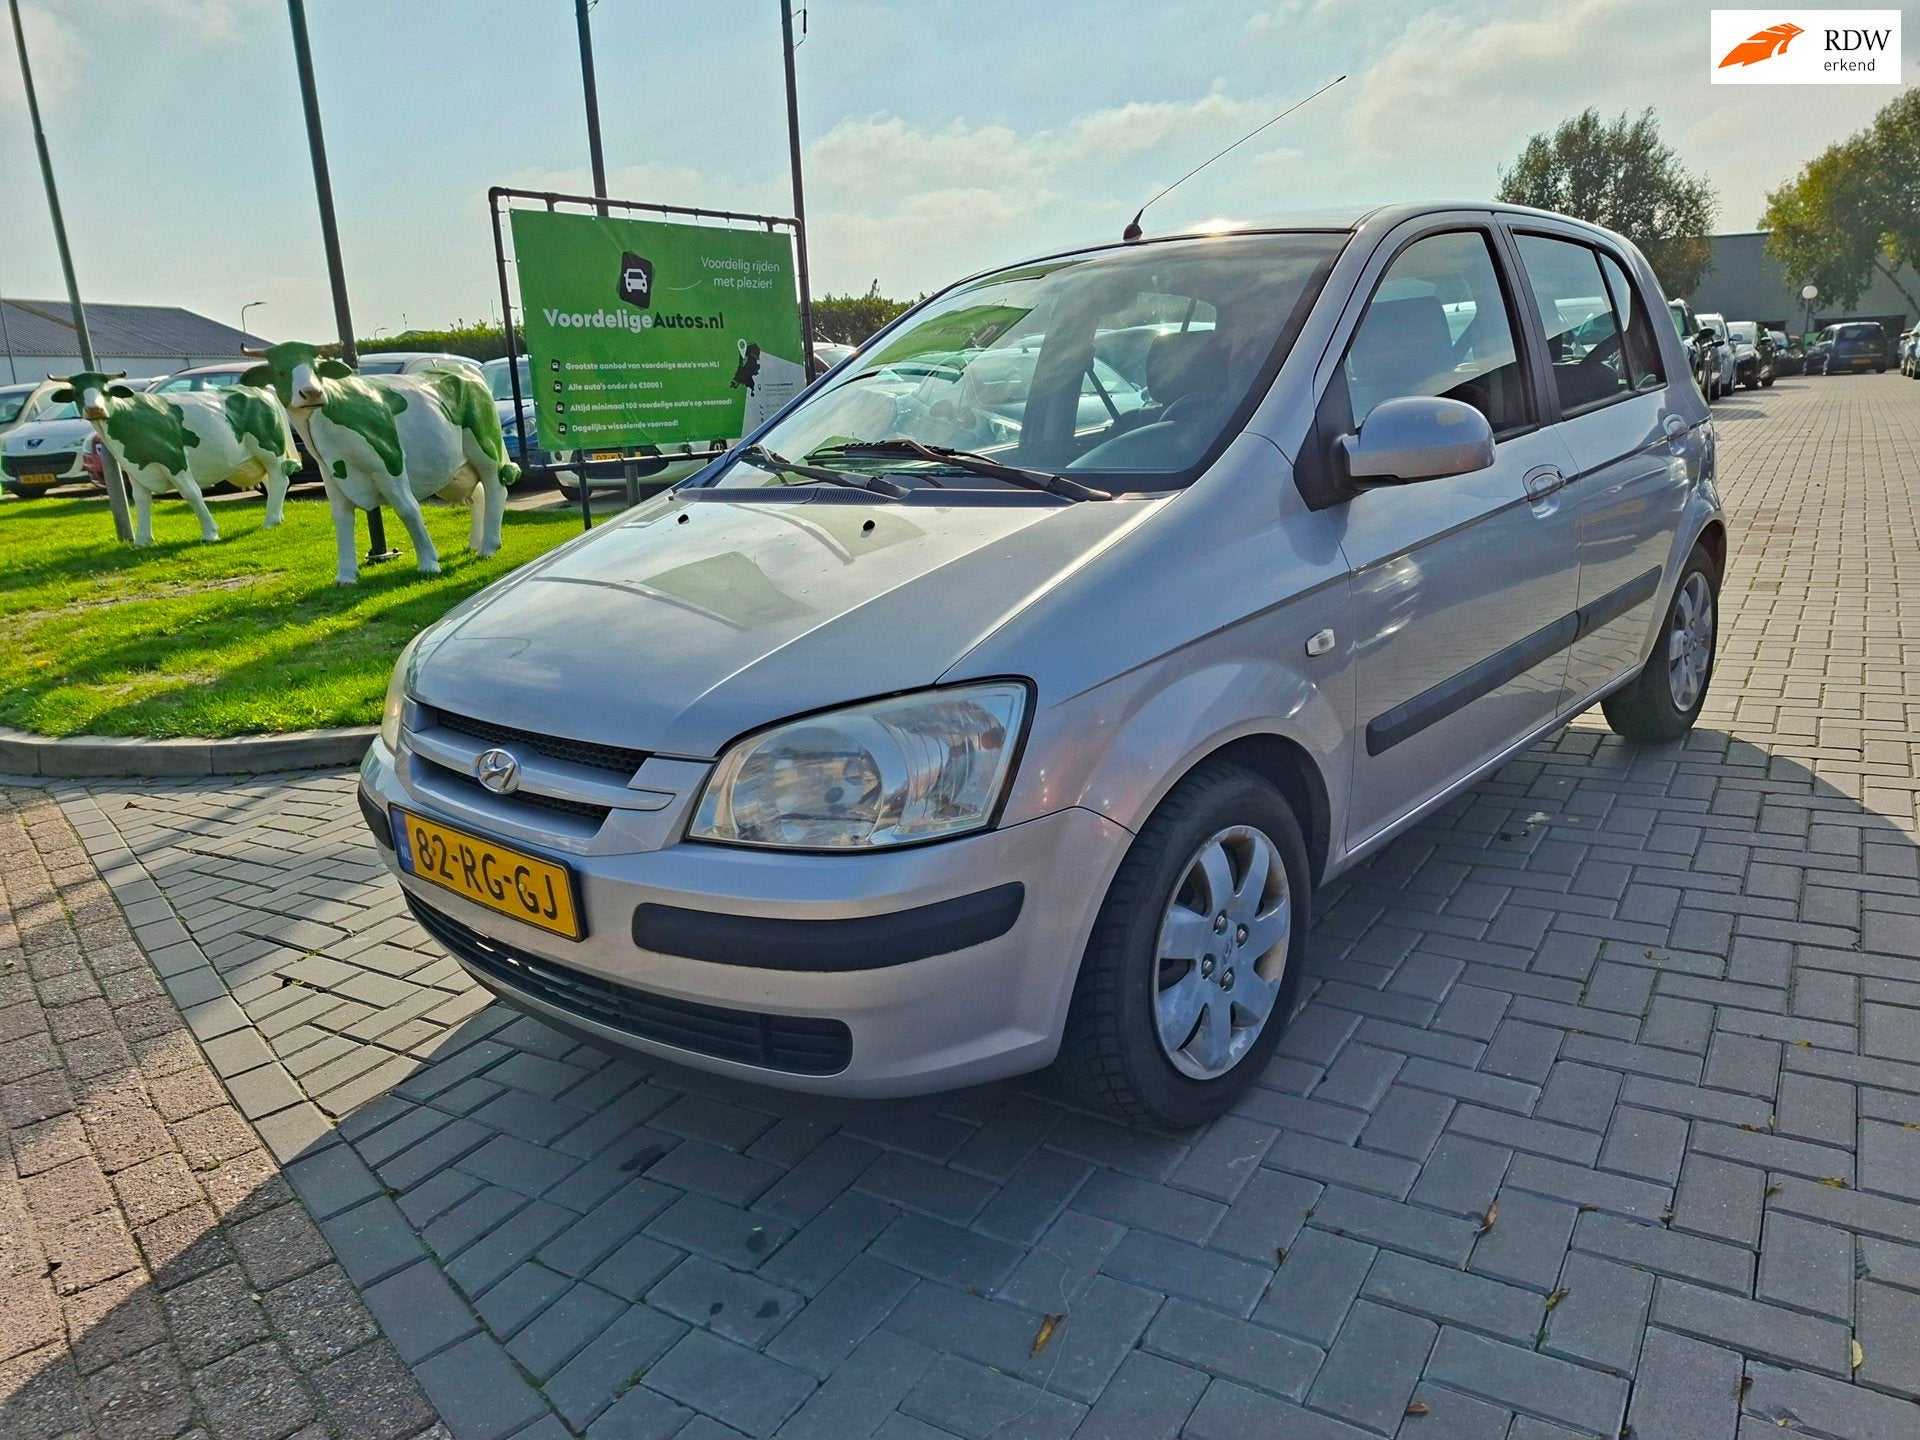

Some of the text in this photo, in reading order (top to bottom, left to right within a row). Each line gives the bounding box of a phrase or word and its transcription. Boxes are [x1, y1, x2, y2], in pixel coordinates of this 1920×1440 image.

[701, 256, 780, 275] Voordelig rijden
[713, 276, 773, 291] met plezier!
[542, 308, 725, 334] VoordeligeAutos.nl
[565, 362, 599, 371] Grootste
[599, 361, 627, 371] aanbod
[627, 362, 641, 370] van
[641, 360, 677, 371] voordelige
[676, 360, 697, 370] auto's
[697, 361, 709, 369] van
[567, 383, 583, 391] Alle
[583, 382, 607, 391] auto's
[607, 382, 629, 390] onder
[628, 382, 638, 390] de
[570, 403, 591, 413] Altijd
[591, 402, 625, 411] minimaal
[625, 401, 638, 410] 100
[637, 400, 674, 410] voordelige
[693, 400, 703, 408] op
[571, 423, 607, 433] Dagelijks
[607, 421, 647, 431] wisselende
[400, 844, 413, 862] NL
[415, 827, 559, 921] 82-RG-GJ
